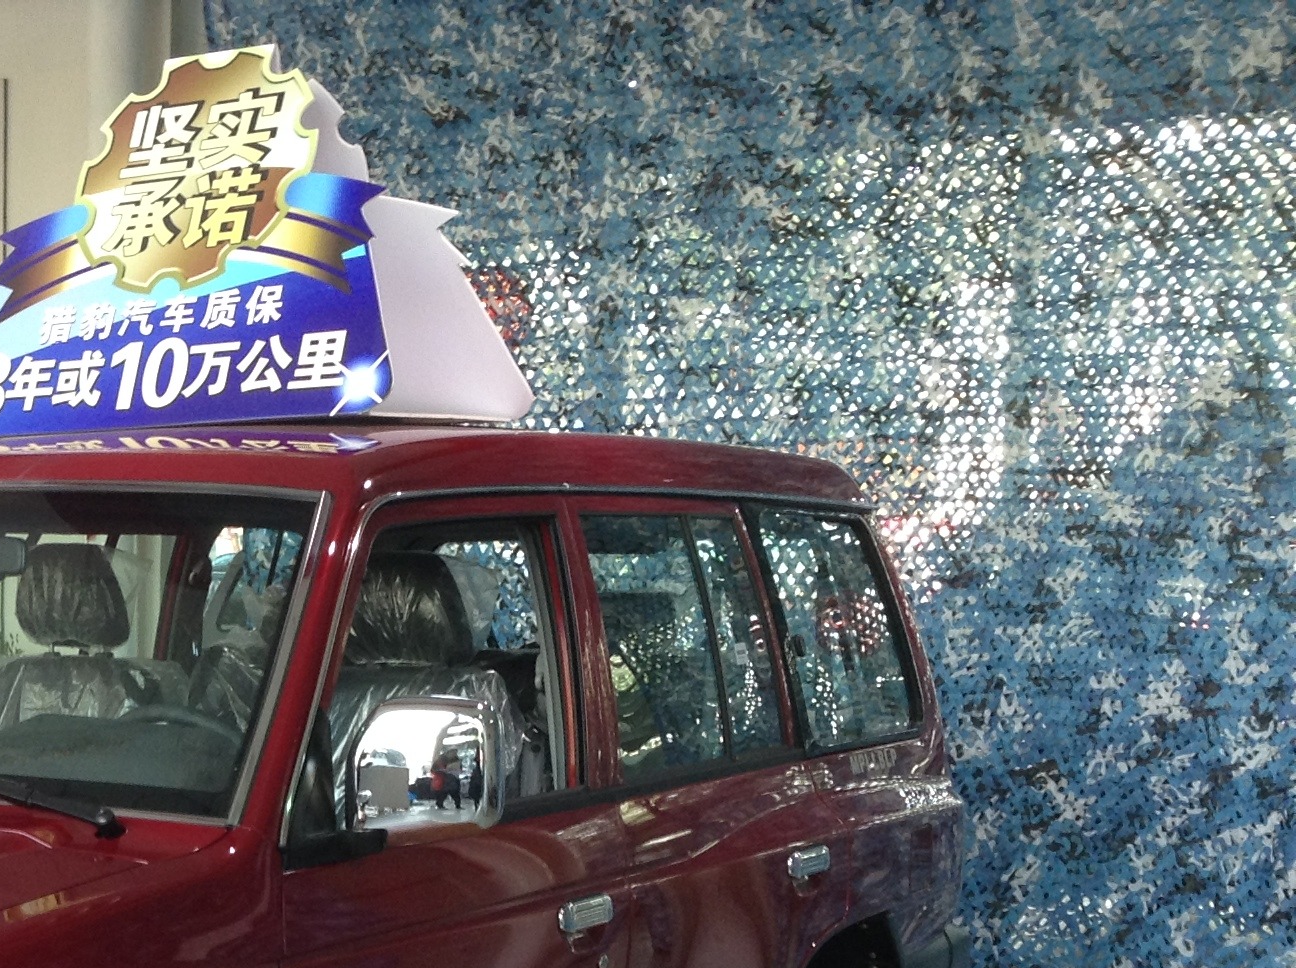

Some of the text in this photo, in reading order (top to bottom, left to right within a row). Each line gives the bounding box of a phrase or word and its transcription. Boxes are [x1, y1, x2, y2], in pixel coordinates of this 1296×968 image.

[119, 91, 282, 180] 坚实
[101, 168, 263, 257] 承诺
[40, 284, 284, 345] 猎豹汽车质保
